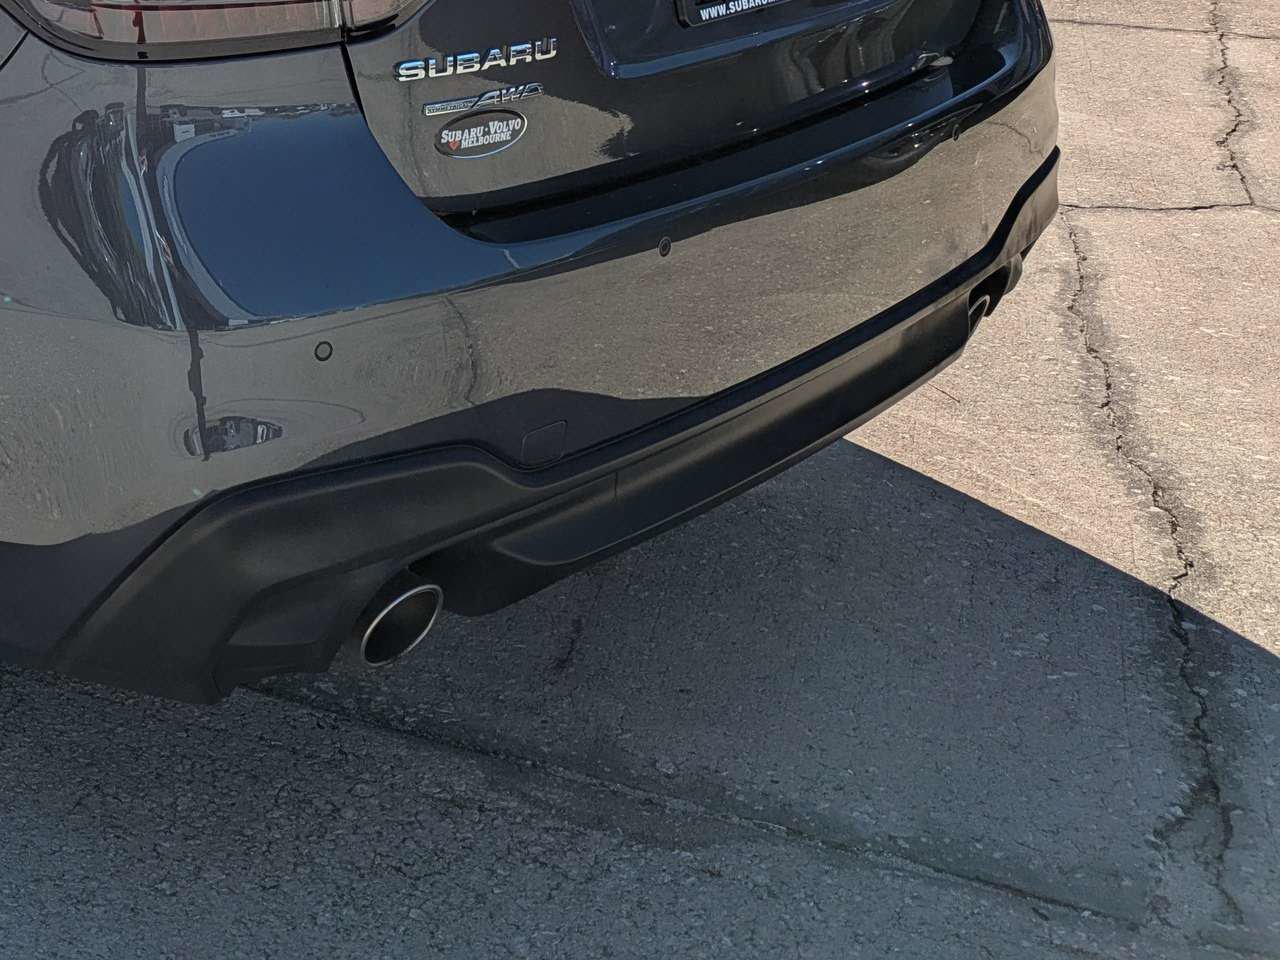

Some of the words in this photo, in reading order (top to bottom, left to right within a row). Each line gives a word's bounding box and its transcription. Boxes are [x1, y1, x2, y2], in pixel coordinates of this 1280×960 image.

[396, 38, 558, 81] SUBARU
[489, 118, 521, 132] VOLVO
[461, 131, 512, 149] MELBOURNE
